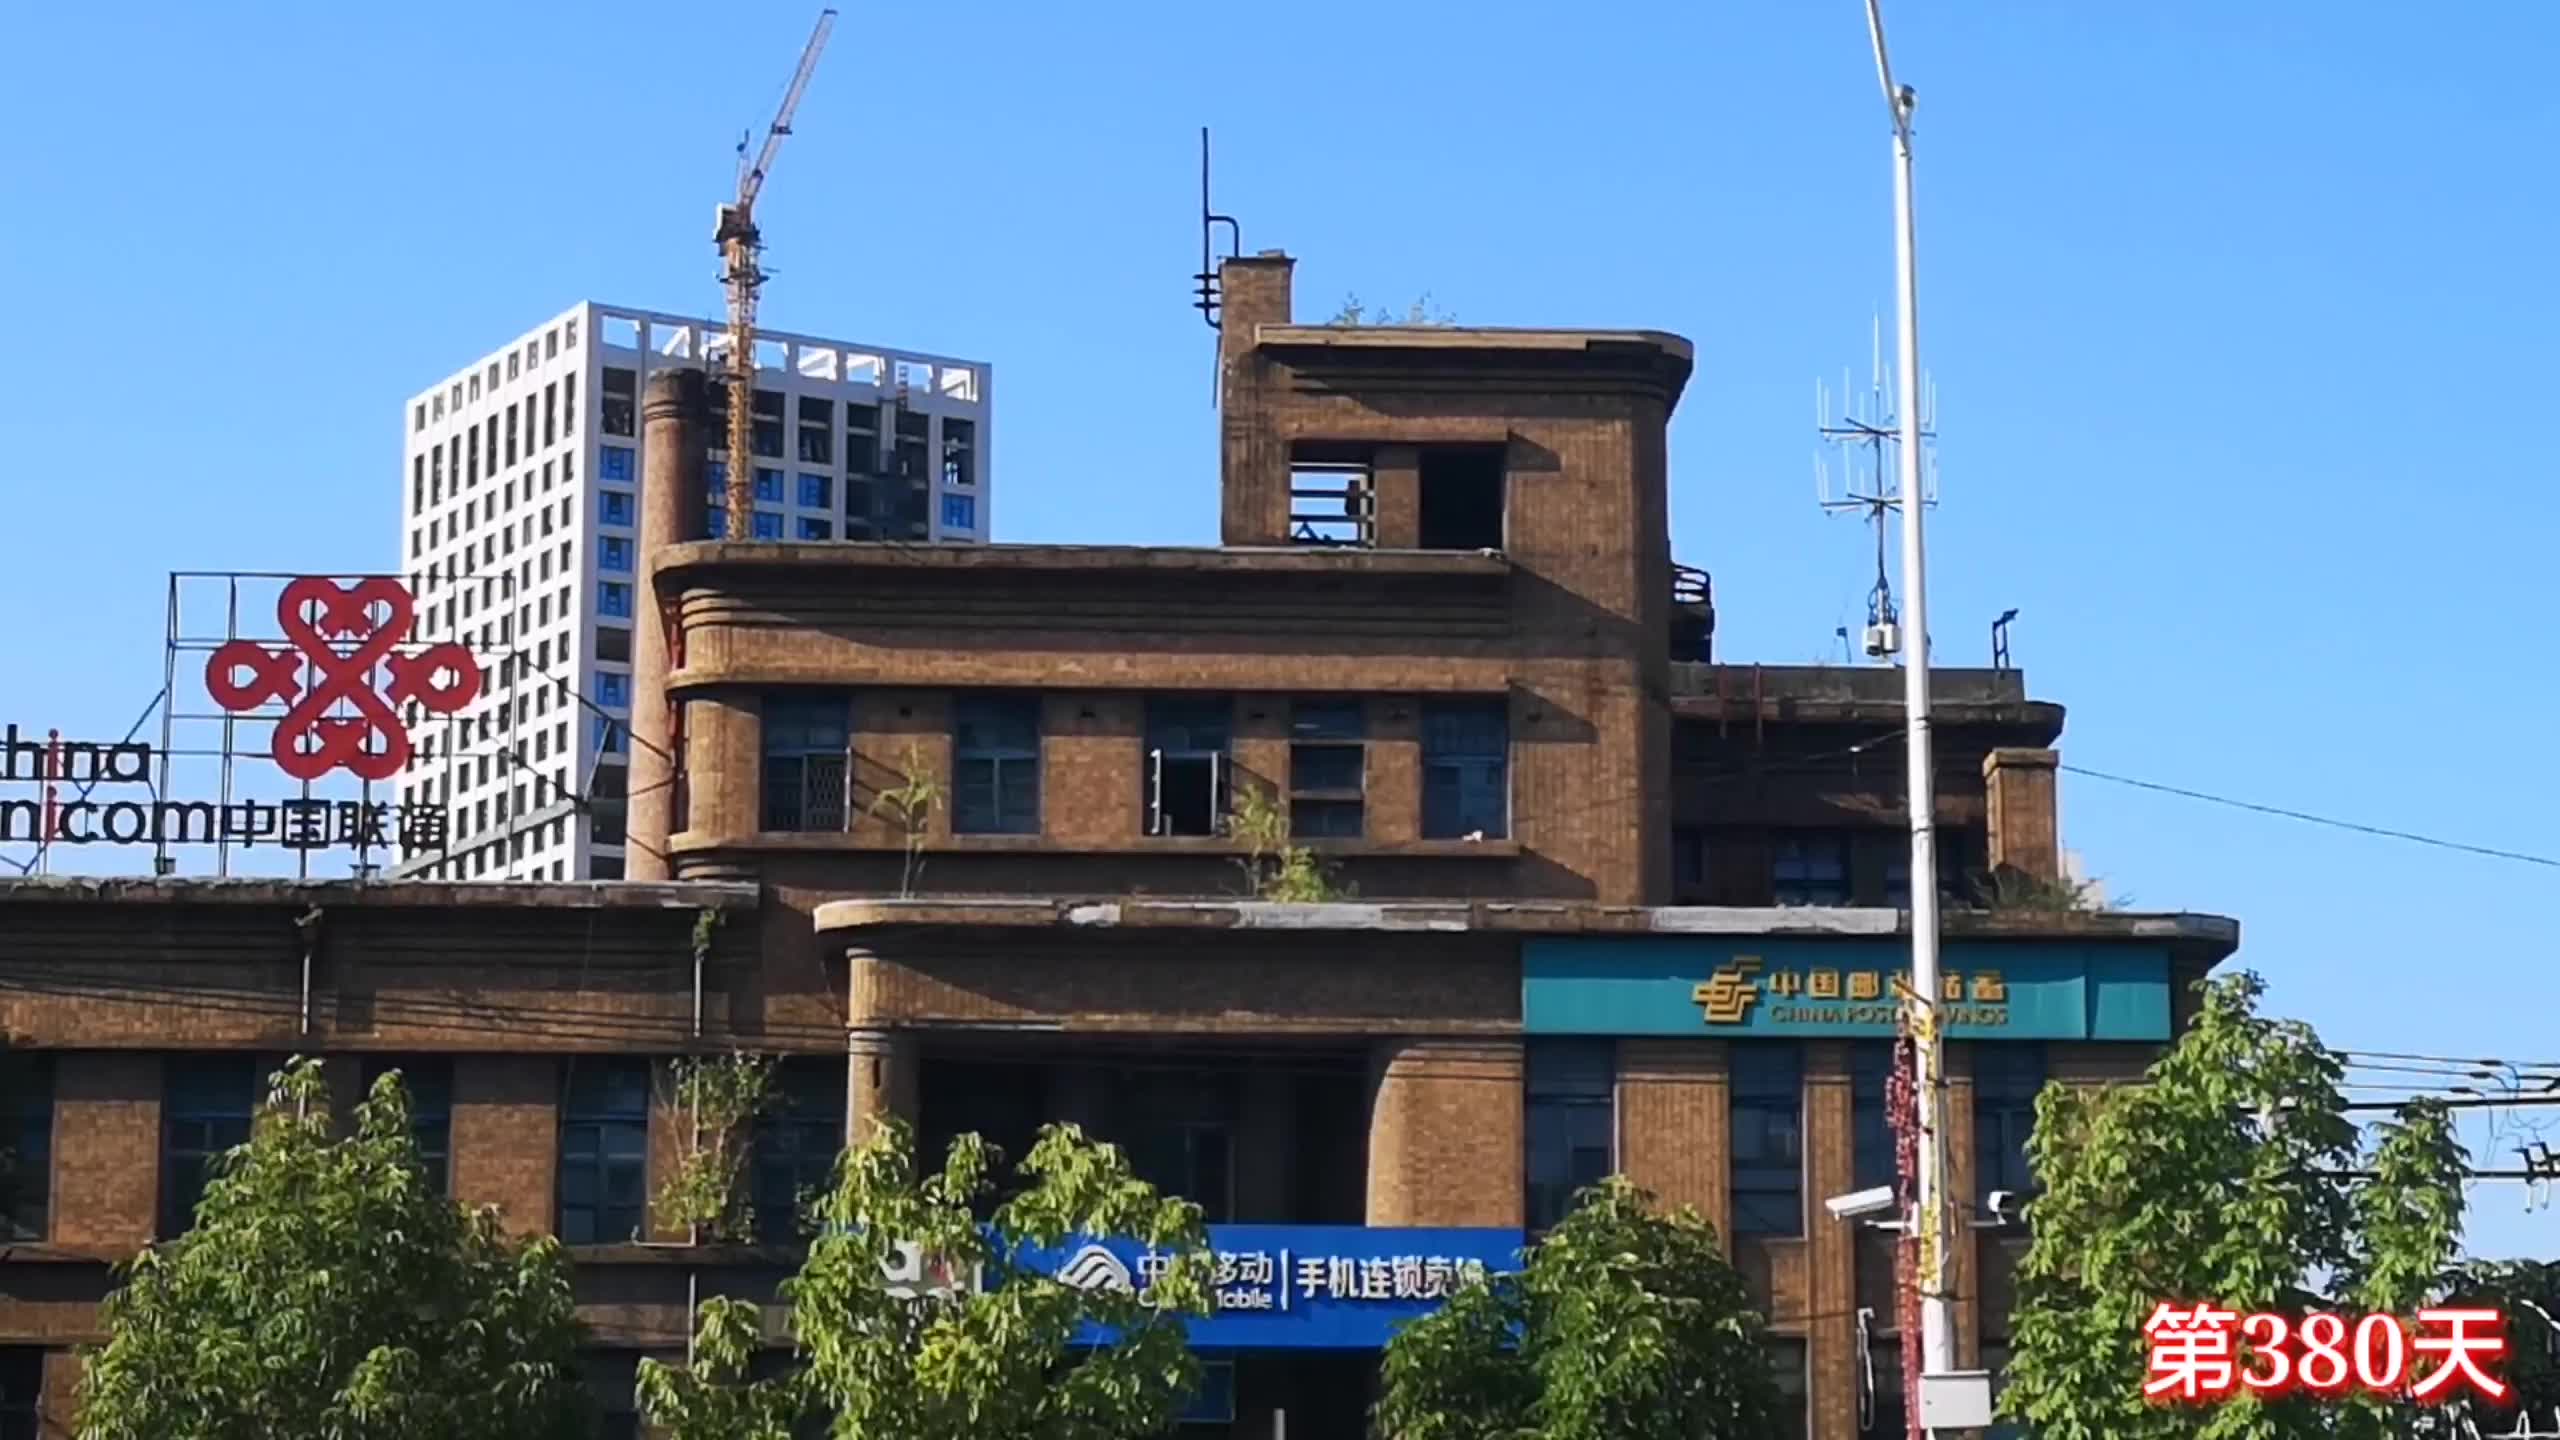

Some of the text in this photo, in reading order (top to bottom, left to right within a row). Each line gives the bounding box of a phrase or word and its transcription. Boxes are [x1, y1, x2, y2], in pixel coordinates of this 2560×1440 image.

[0, 723, 150, 781] hina
[221, 799, 447, 852] 中国联通
[1770, 1006, 1841, 1024] CHINA
[1136, 1247, 1273, 1287] 中移动
[1215, 1287, 1273, 1310] obile
